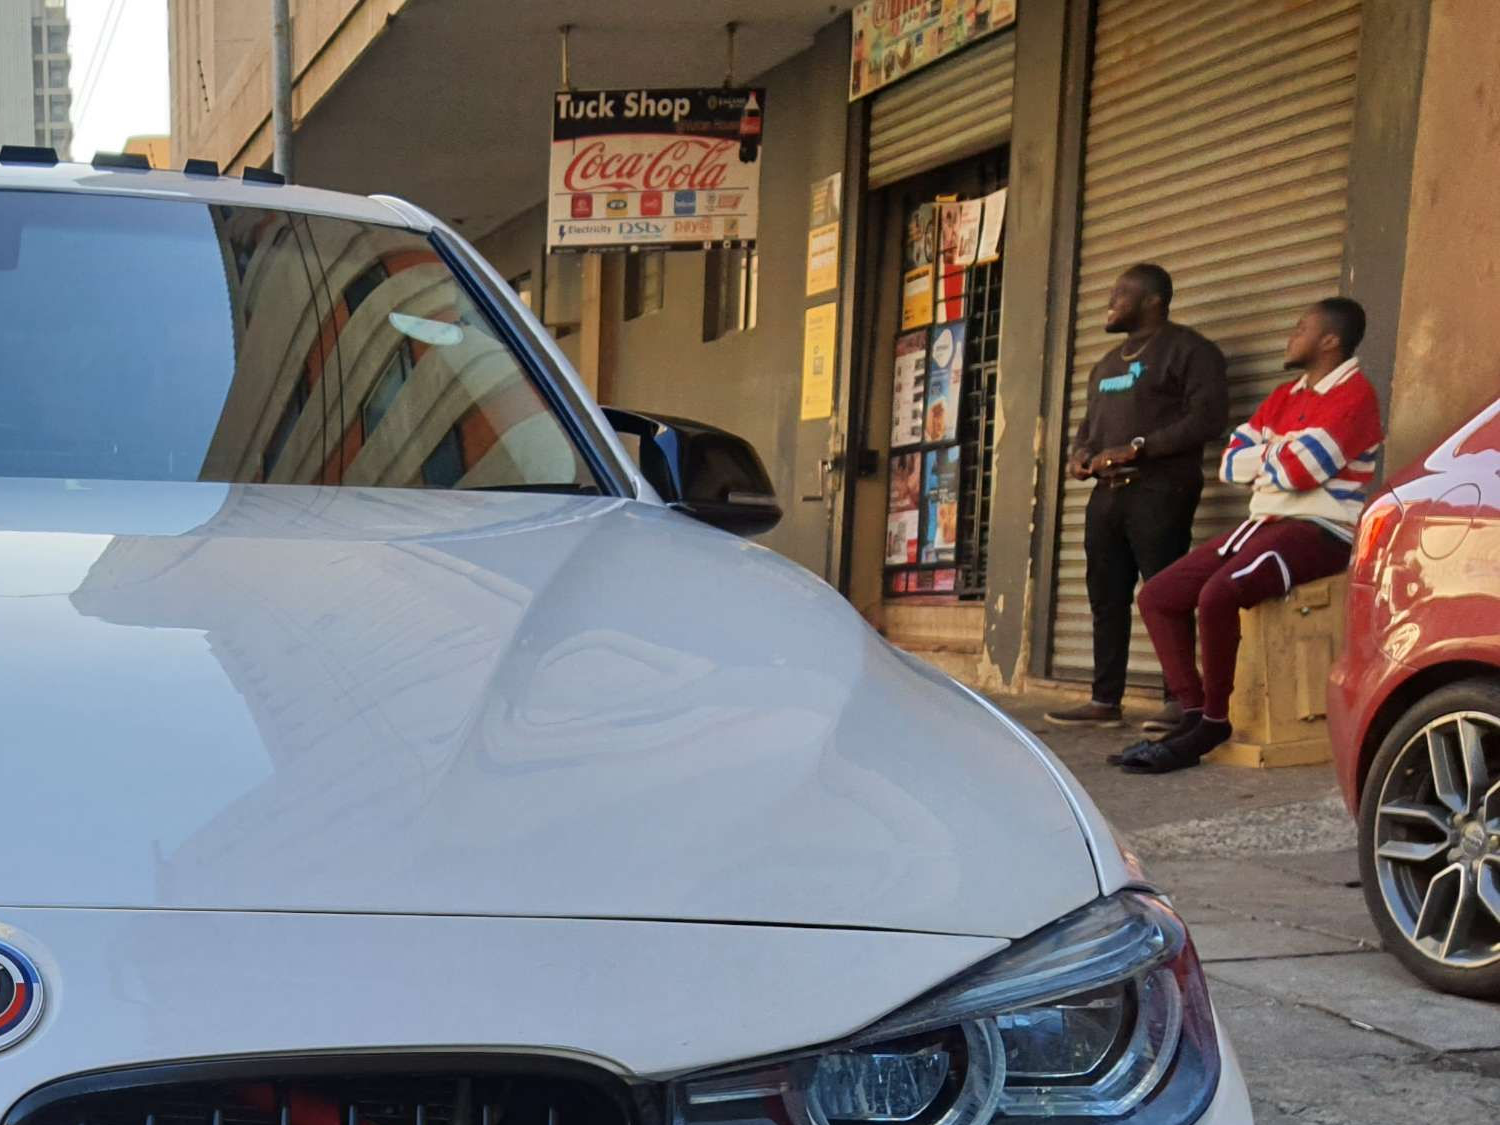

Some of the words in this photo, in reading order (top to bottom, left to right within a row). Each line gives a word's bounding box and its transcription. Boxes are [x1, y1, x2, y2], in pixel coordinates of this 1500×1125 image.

[557, 91, 615, 120] Tuck
[623, 90, 691, 123] Shop
[564, 139, 735, 192] Coca-Cola
[568, 223, 612, 235] Electricity
